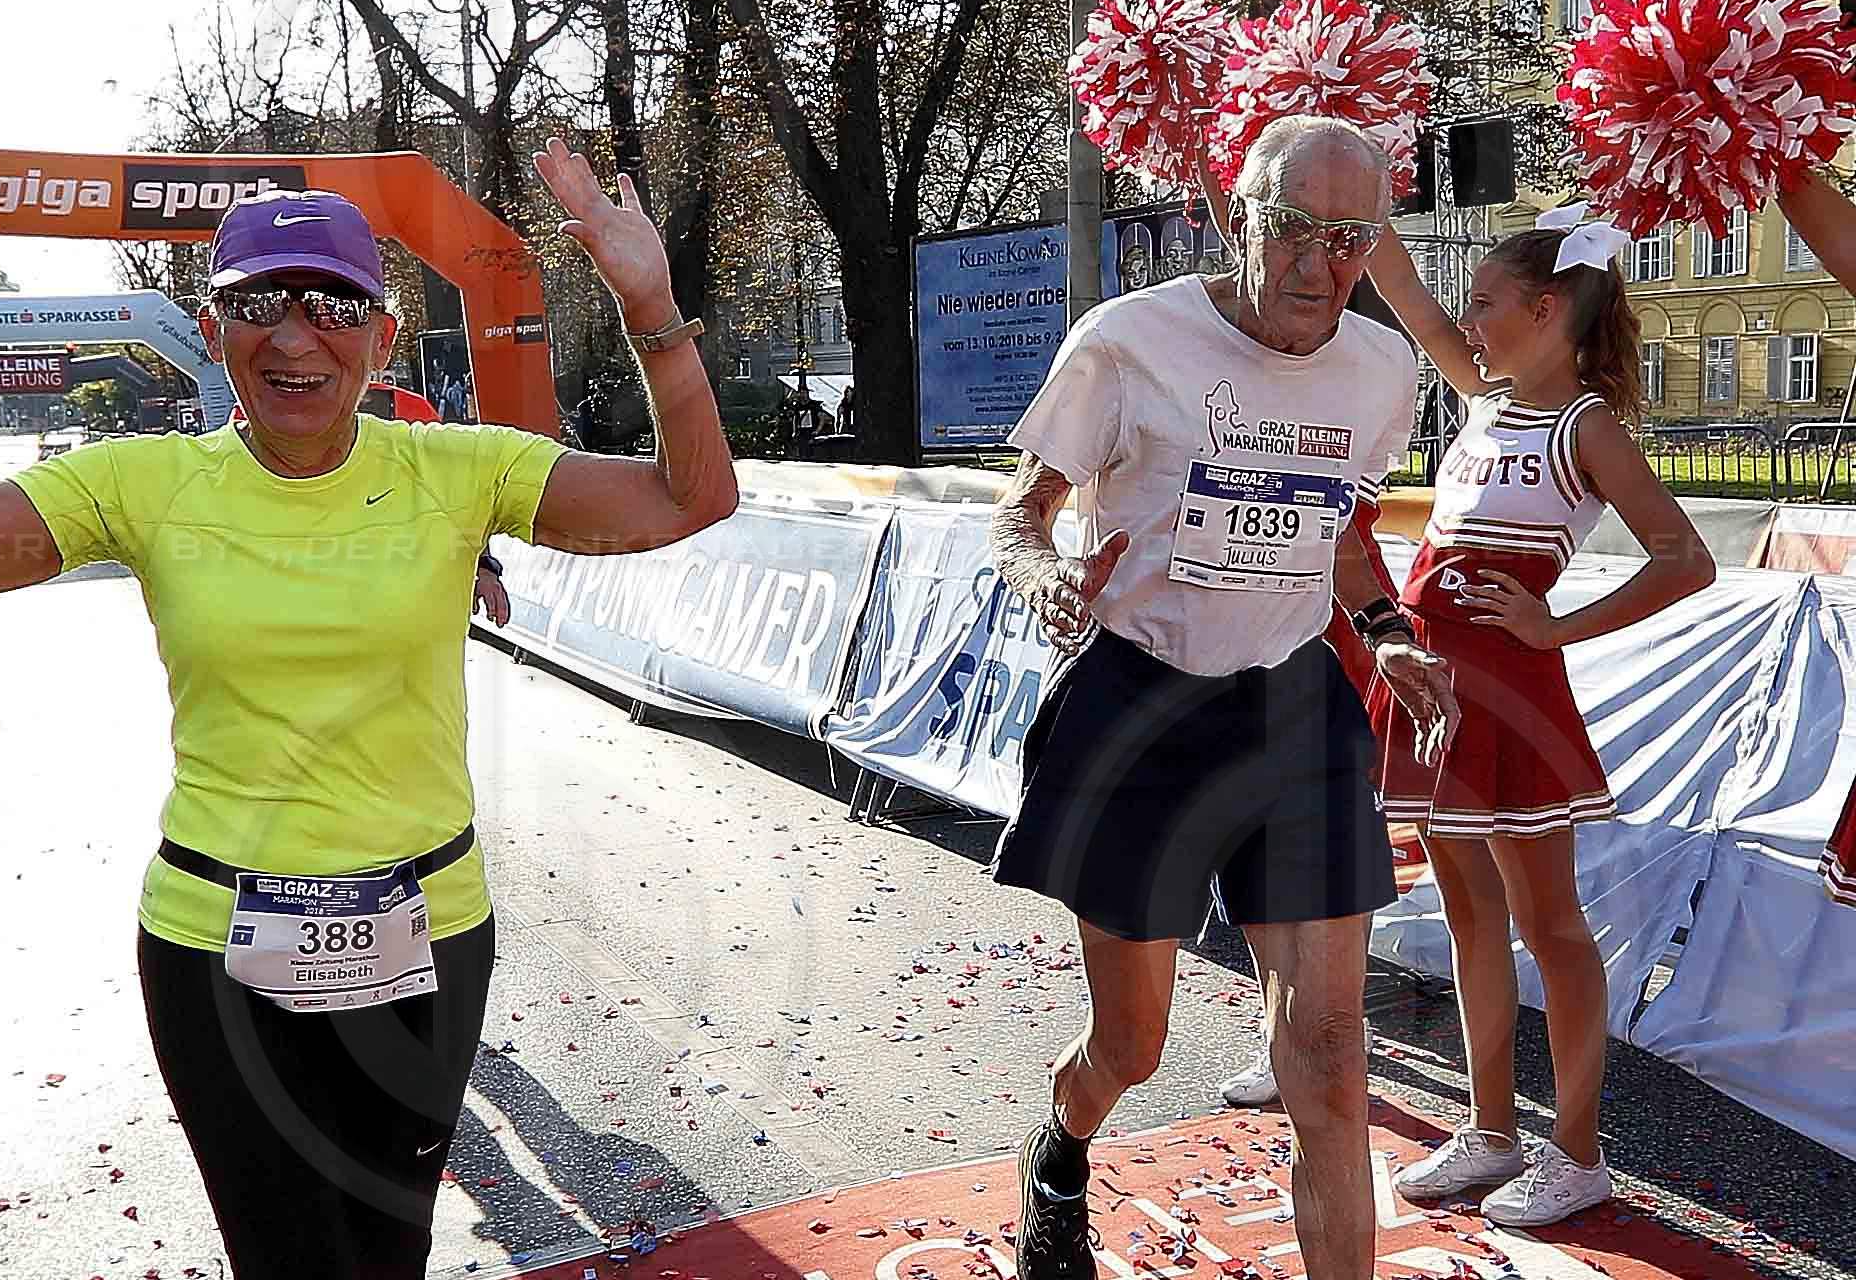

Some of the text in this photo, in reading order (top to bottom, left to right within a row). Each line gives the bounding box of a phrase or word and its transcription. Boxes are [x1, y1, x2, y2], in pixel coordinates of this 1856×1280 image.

[937, 285, 1066, 317] Nie wieder arbe
[37, 310, 118, 324] SPARKASSE
[484, 322, 543, 338] giga sport
[943, 338, 965, 351] vom
[1026, 332, 1043, 346] bis
[1258, 419, 1297, 439] GRAZ
[1300, 426, 1351, 445] KLEINE
[1222, 432, 1296, 456] MARATHON
[1300, 443, 1349, 458] ZEITUNG
[1229, 469, 1268, 486] GRAZ
[1224, 504, 1302, 540] 1839
[284, 880, 334, 898] GRAZ
[273, 895, 318, 907] MARATHON
[297, 919, 376, 955] 388
[295, 965, 373, 982] Elisabeth
